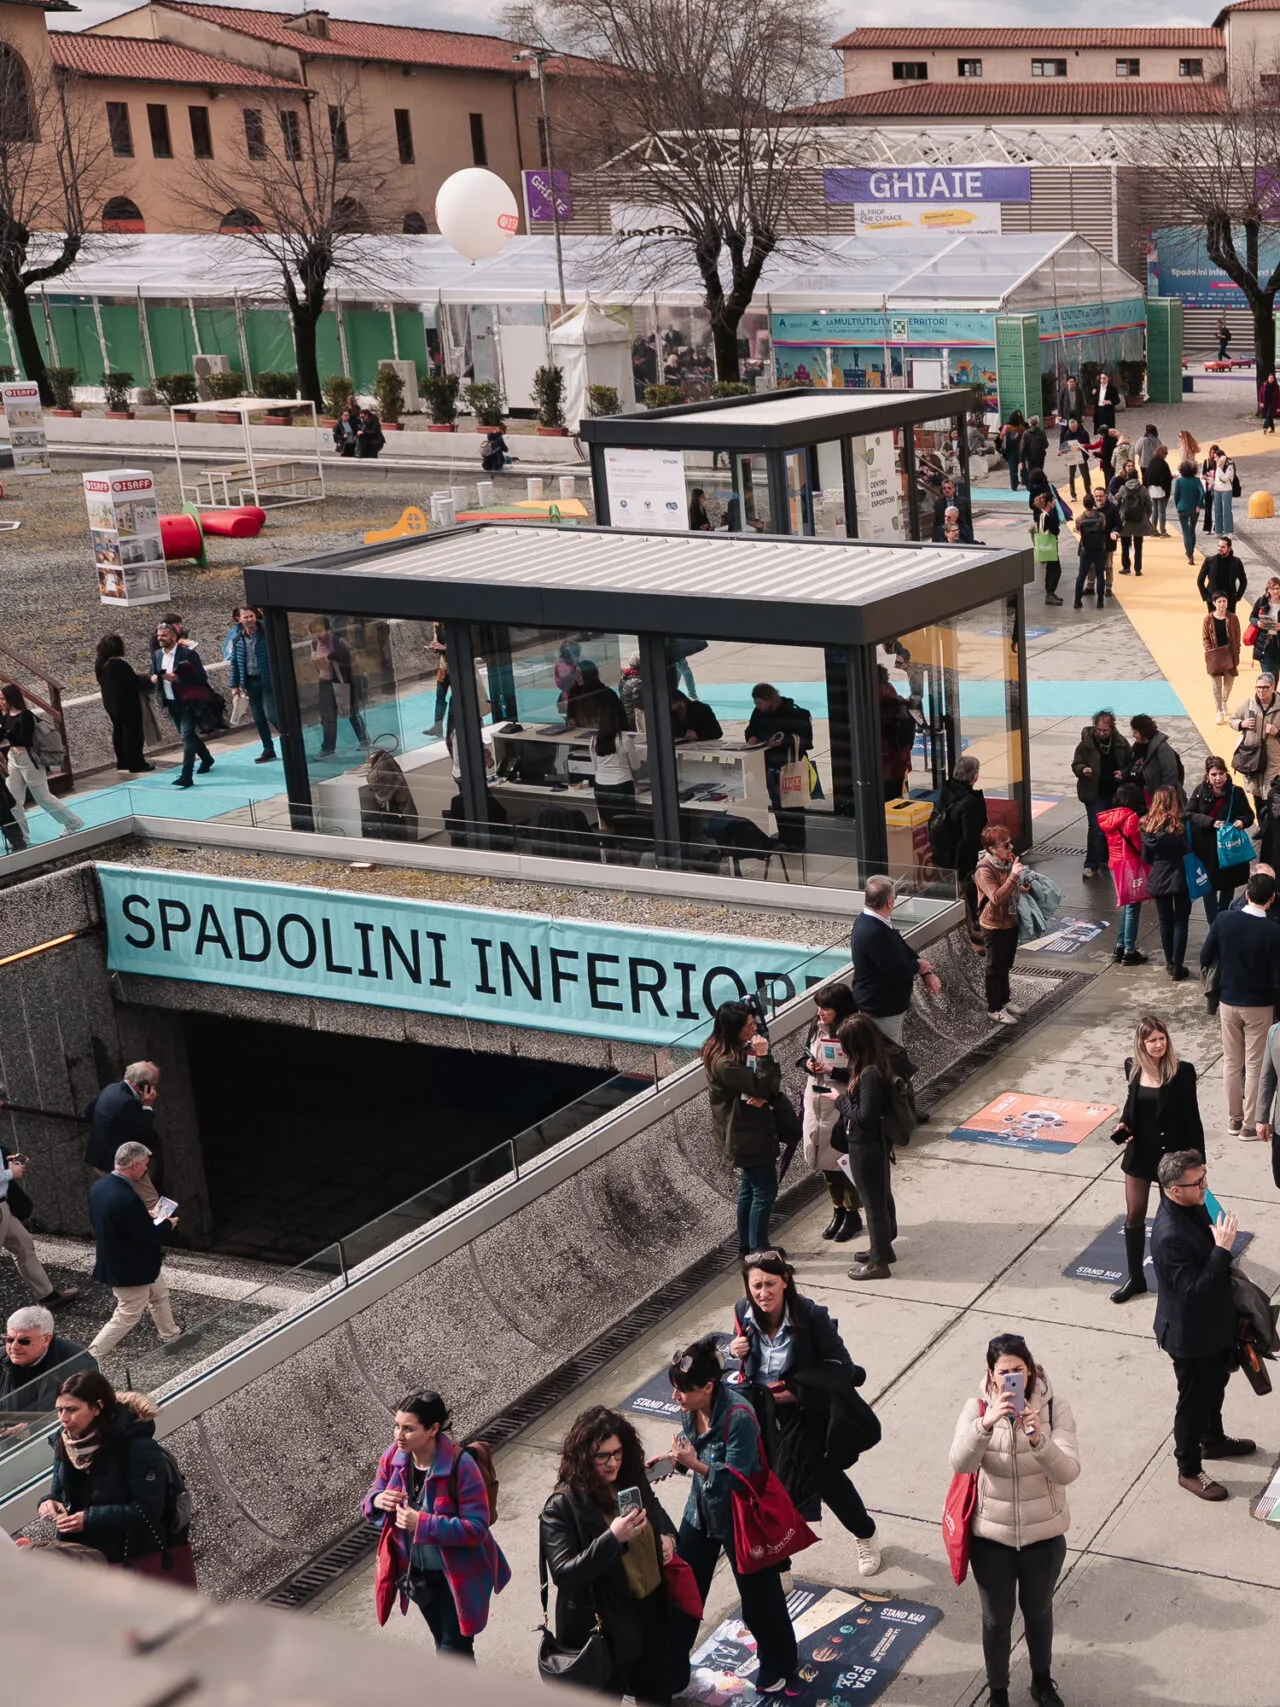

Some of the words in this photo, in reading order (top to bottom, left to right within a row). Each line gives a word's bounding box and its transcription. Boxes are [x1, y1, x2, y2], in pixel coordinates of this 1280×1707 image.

[869, 171, 983, 199] GHIAIE
[531, 174, 568, 215] GHIIE
[834, 317, 890, 327] MULTIUTILITY
[908, 317, 948, 327] ERRITORI
[121, 479, 150, 491] ISAFF
[1132, 877, 1143, 888] EF
[121, 893, 451, 989] SPADOLINI
[470, 937, 824, 1021] INFERIOR
[1076, 1266, 1104, 1276] STAND
[633, 1397, 664, 1409] STAND
[880, 1608, 909, 1619] STAND
[851, 1667, 877, 1690] GRA
